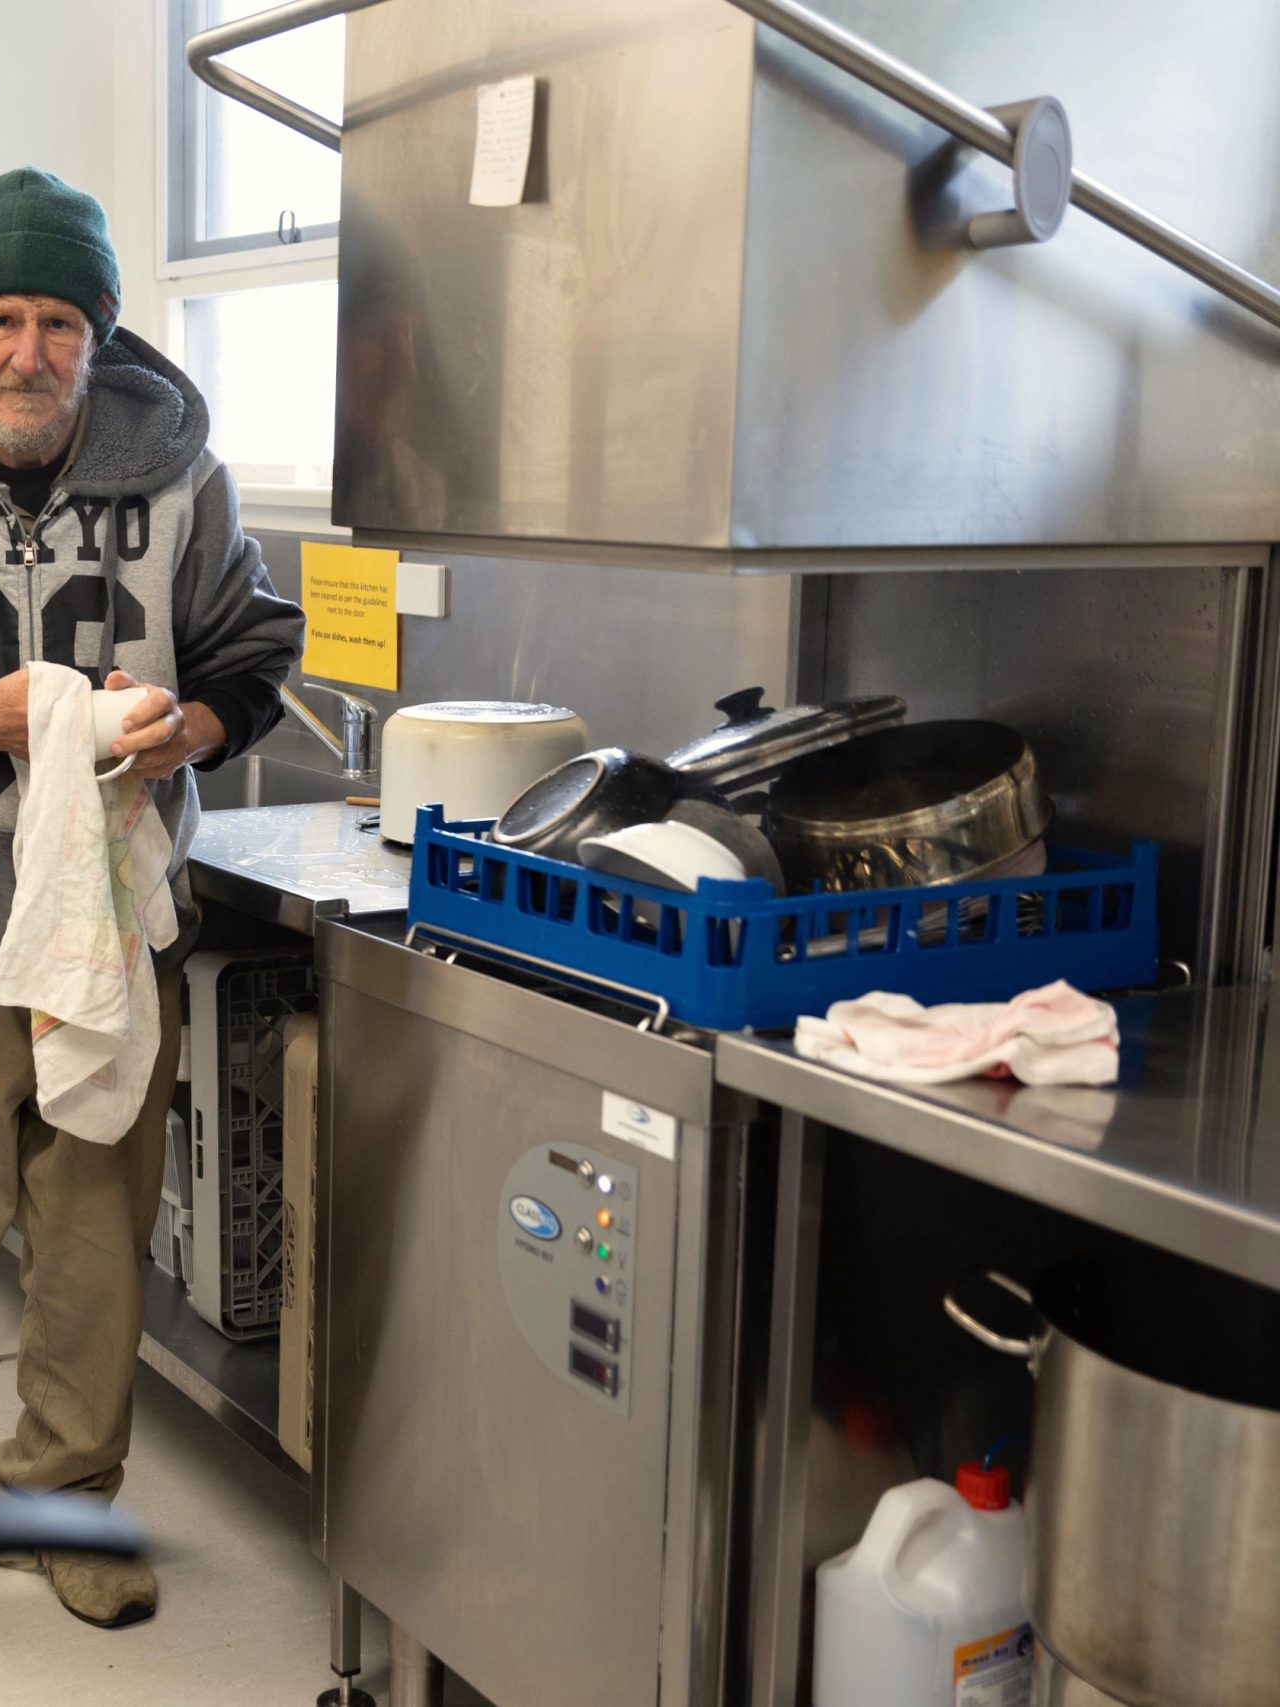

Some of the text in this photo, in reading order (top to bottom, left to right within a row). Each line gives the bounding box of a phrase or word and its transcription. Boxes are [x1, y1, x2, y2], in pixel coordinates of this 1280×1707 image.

[311, 577, 388, 593] Please ensure that this kitchen has
[311, 590, 320, 598] been
[321, 592, 337, 601] cleaned
[353, 596, 362, 604] the
[363, 598, 388, 608] guidelines
[343, 608, 352, 616] the
[332, 632, 348, 643] dishes,
[349, 635, 362, 644] wash
[363, 637, 376, 647] them
[377, 639, 386, 649] up!
